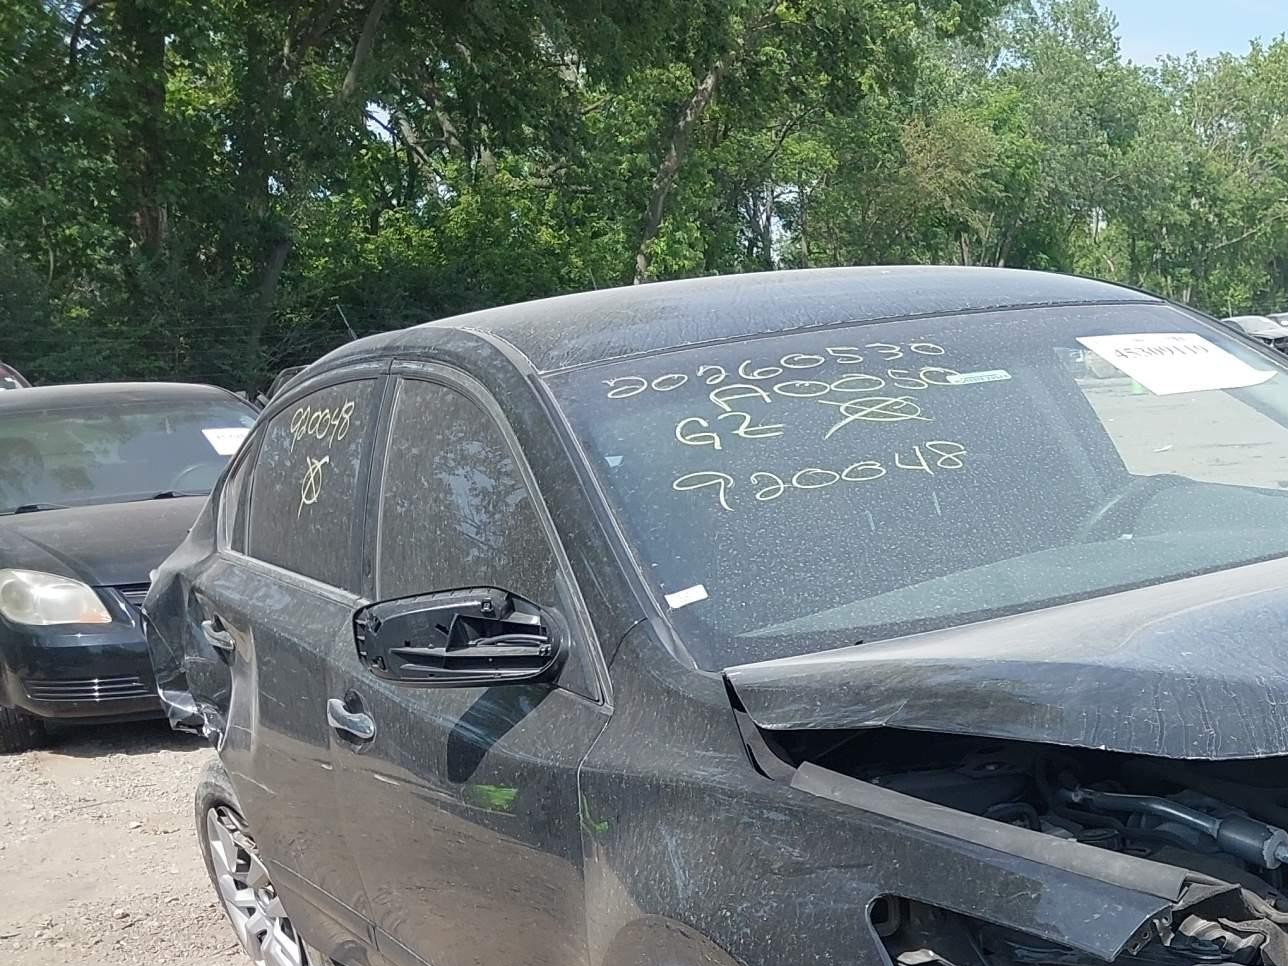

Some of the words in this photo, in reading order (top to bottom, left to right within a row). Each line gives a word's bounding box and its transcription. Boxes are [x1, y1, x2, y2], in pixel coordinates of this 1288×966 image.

[602, 342, 945, 398] 20260530
[291, 400, 355, 453] 920048
[673, 441, 967, 511] 920048
